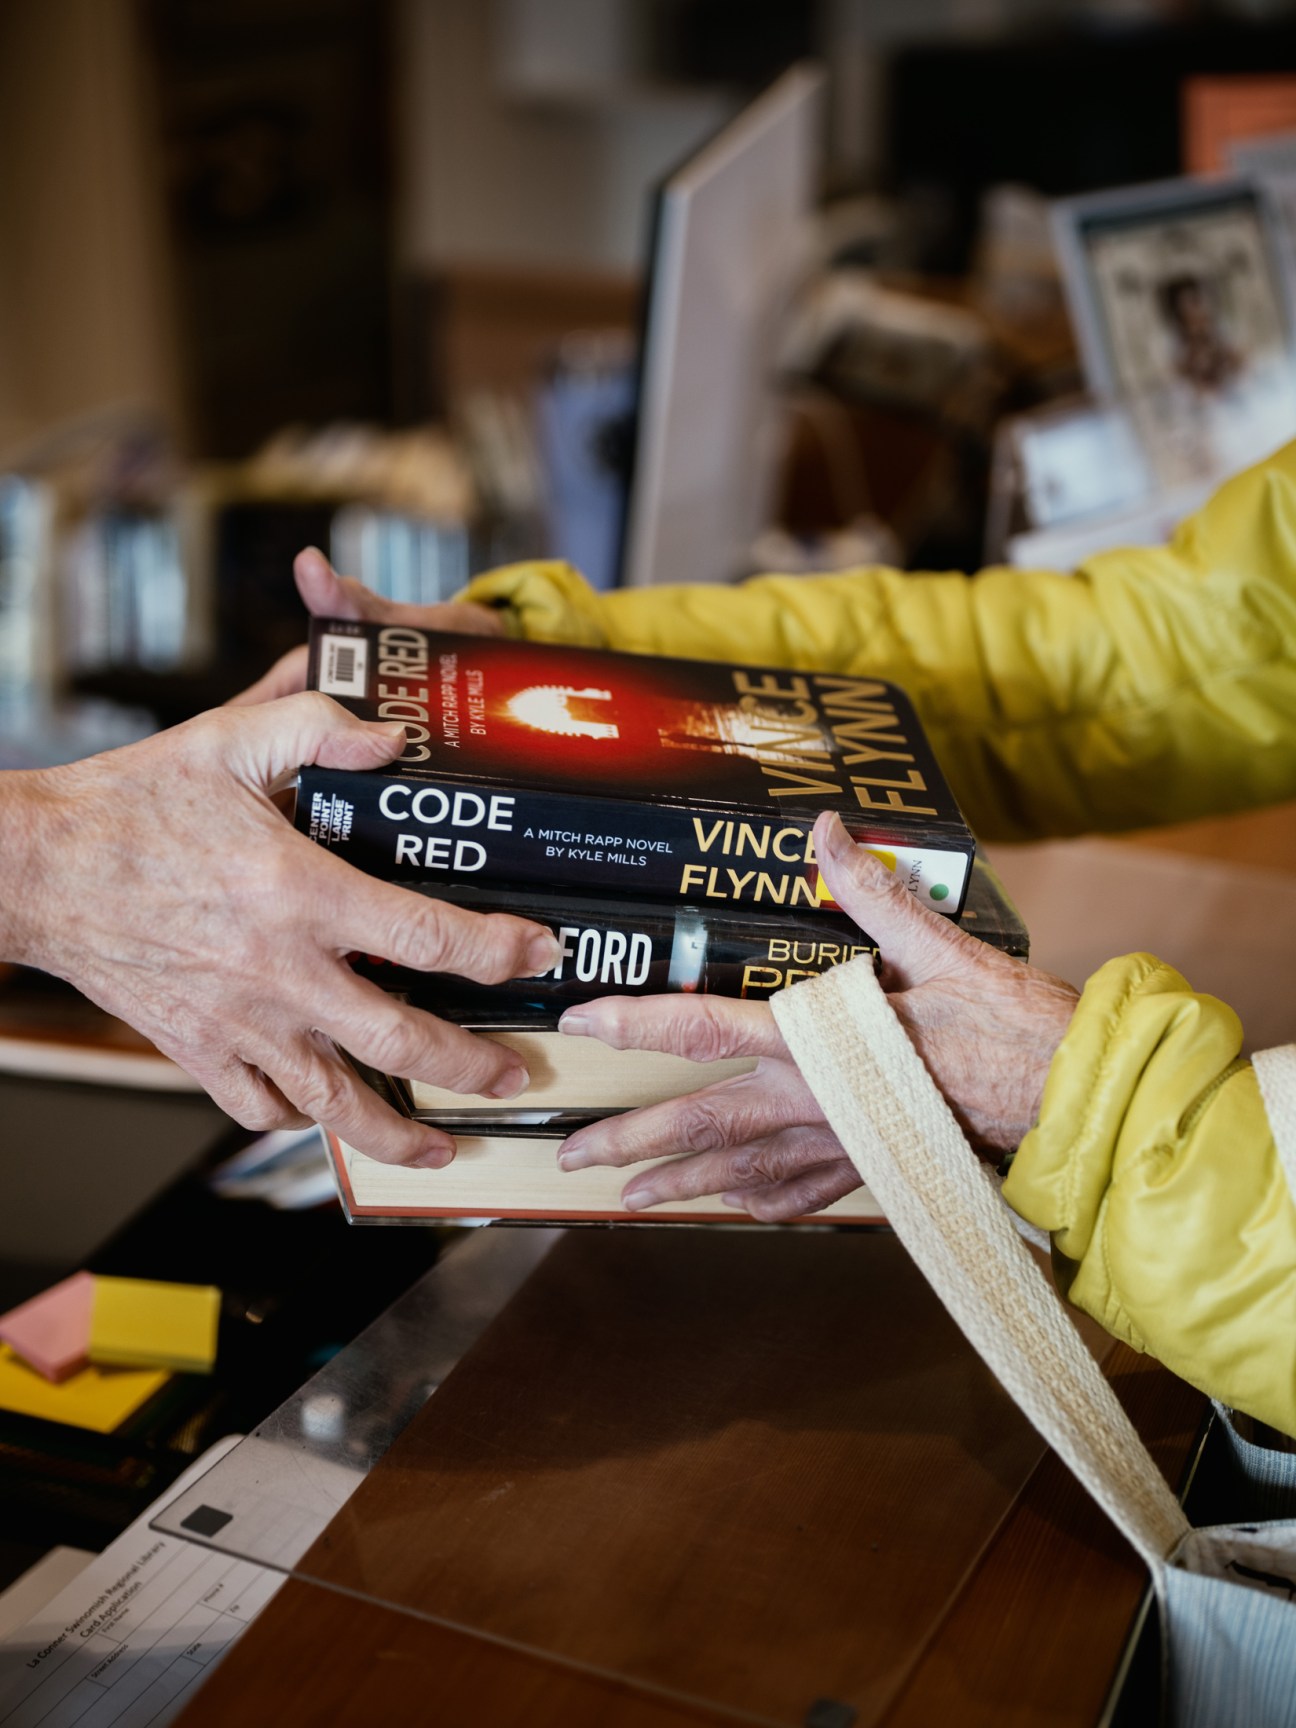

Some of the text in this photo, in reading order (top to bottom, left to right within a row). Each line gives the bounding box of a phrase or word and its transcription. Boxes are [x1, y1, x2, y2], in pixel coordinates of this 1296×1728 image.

[378, 628, 431, 762] CODE RED
[439, 653, 460, 748] A MITCH RAPP NOVEL
[466, 669, 486, 735] BY KYLE MILLS
[732, 671, 843, 797] VINCE
[813, 677, 938, 816] FLYNN
[319, 799, 331, 839] POINT
[331, 799, 345, 841] LARGE
[341, 802, 354, 840] PRINT
[379, 784, 515, 831] CODE
[395, 834, 487, 872] RED
[523, 827, 673, 853] A MITCH RAPP NOVEL
[545, 846, 647, 866] BY KYLE MILLS
[679, 863, 822, 908] FLYNN
[908, 860, 922, 893] LYNN
[536, 926, 653, 986] FORD
[26, 1541, 166, 1669] La Conner Swinomish Regional Library
[80, 1582, 142, 1638] Card Application
